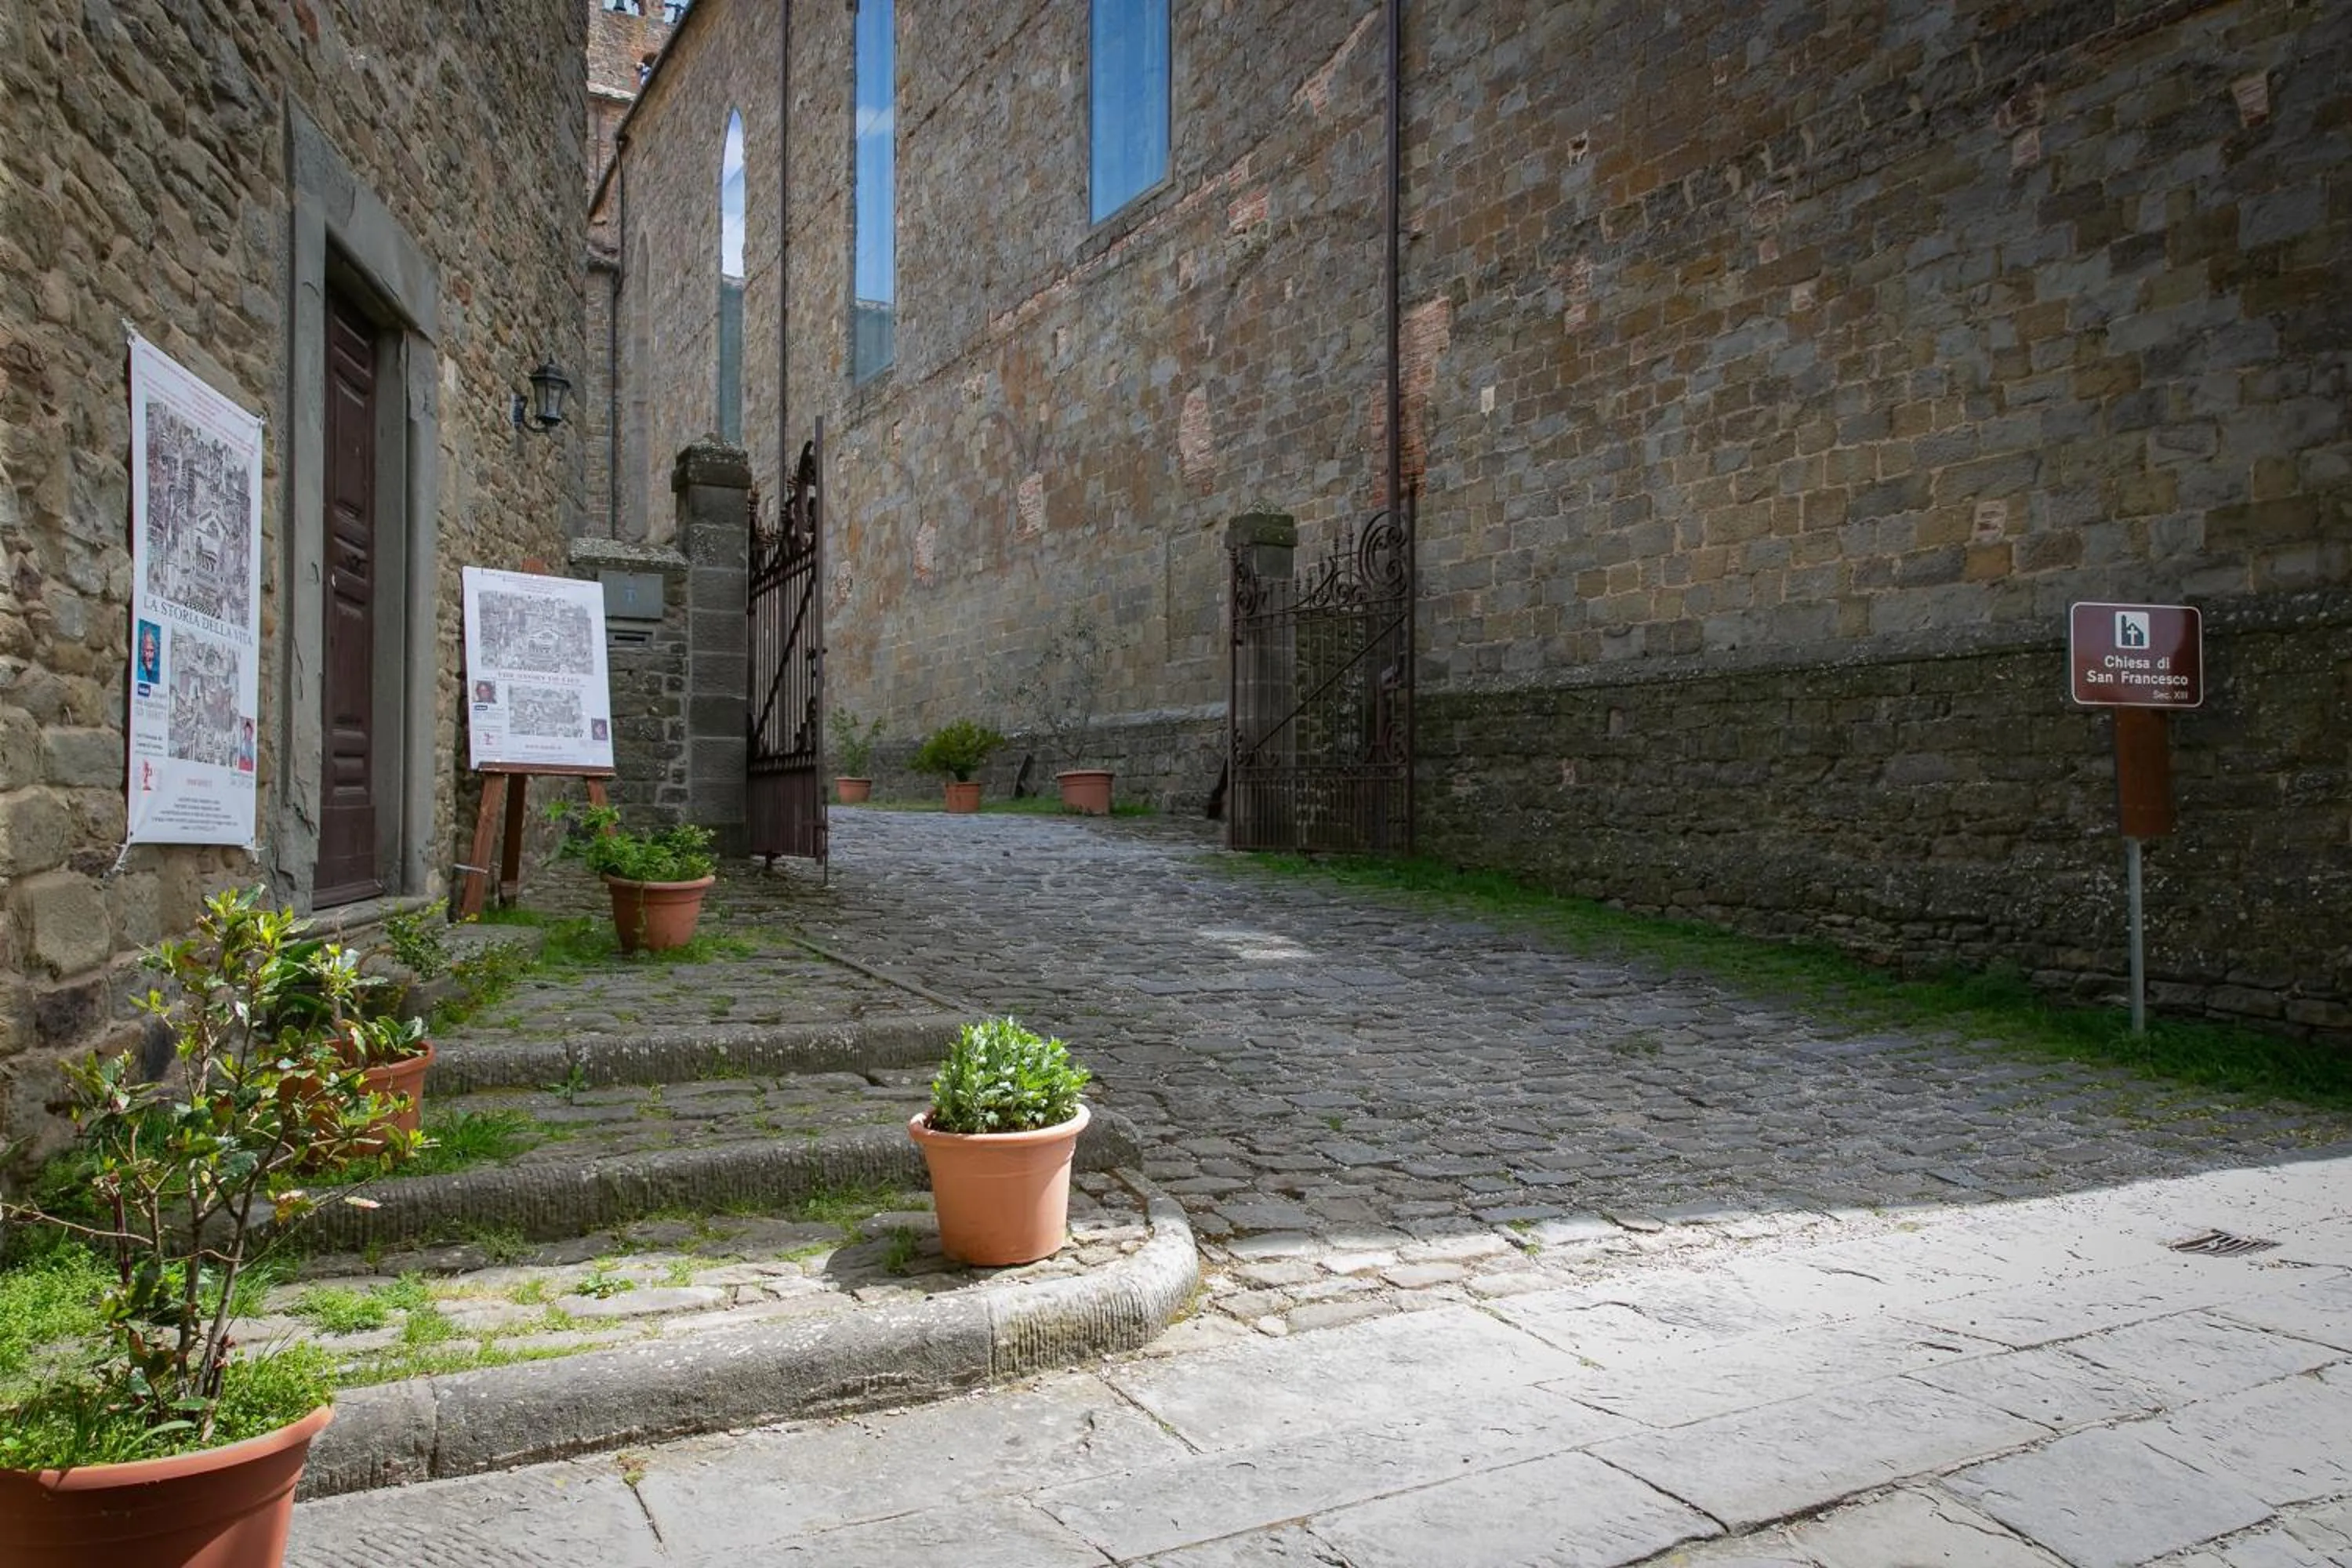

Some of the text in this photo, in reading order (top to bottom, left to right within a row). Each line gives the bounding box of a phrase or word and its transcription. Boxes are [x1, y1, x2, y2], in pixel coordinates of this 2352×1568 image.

[143, 595, 158, 613] LA
[161, 601, 200, 626] STORIA
[201, 616, 232, 637] DELLA
[2104, 655, 2171, 670] Chiesa di
[2086, 670, 2188, 685] San Francesco
